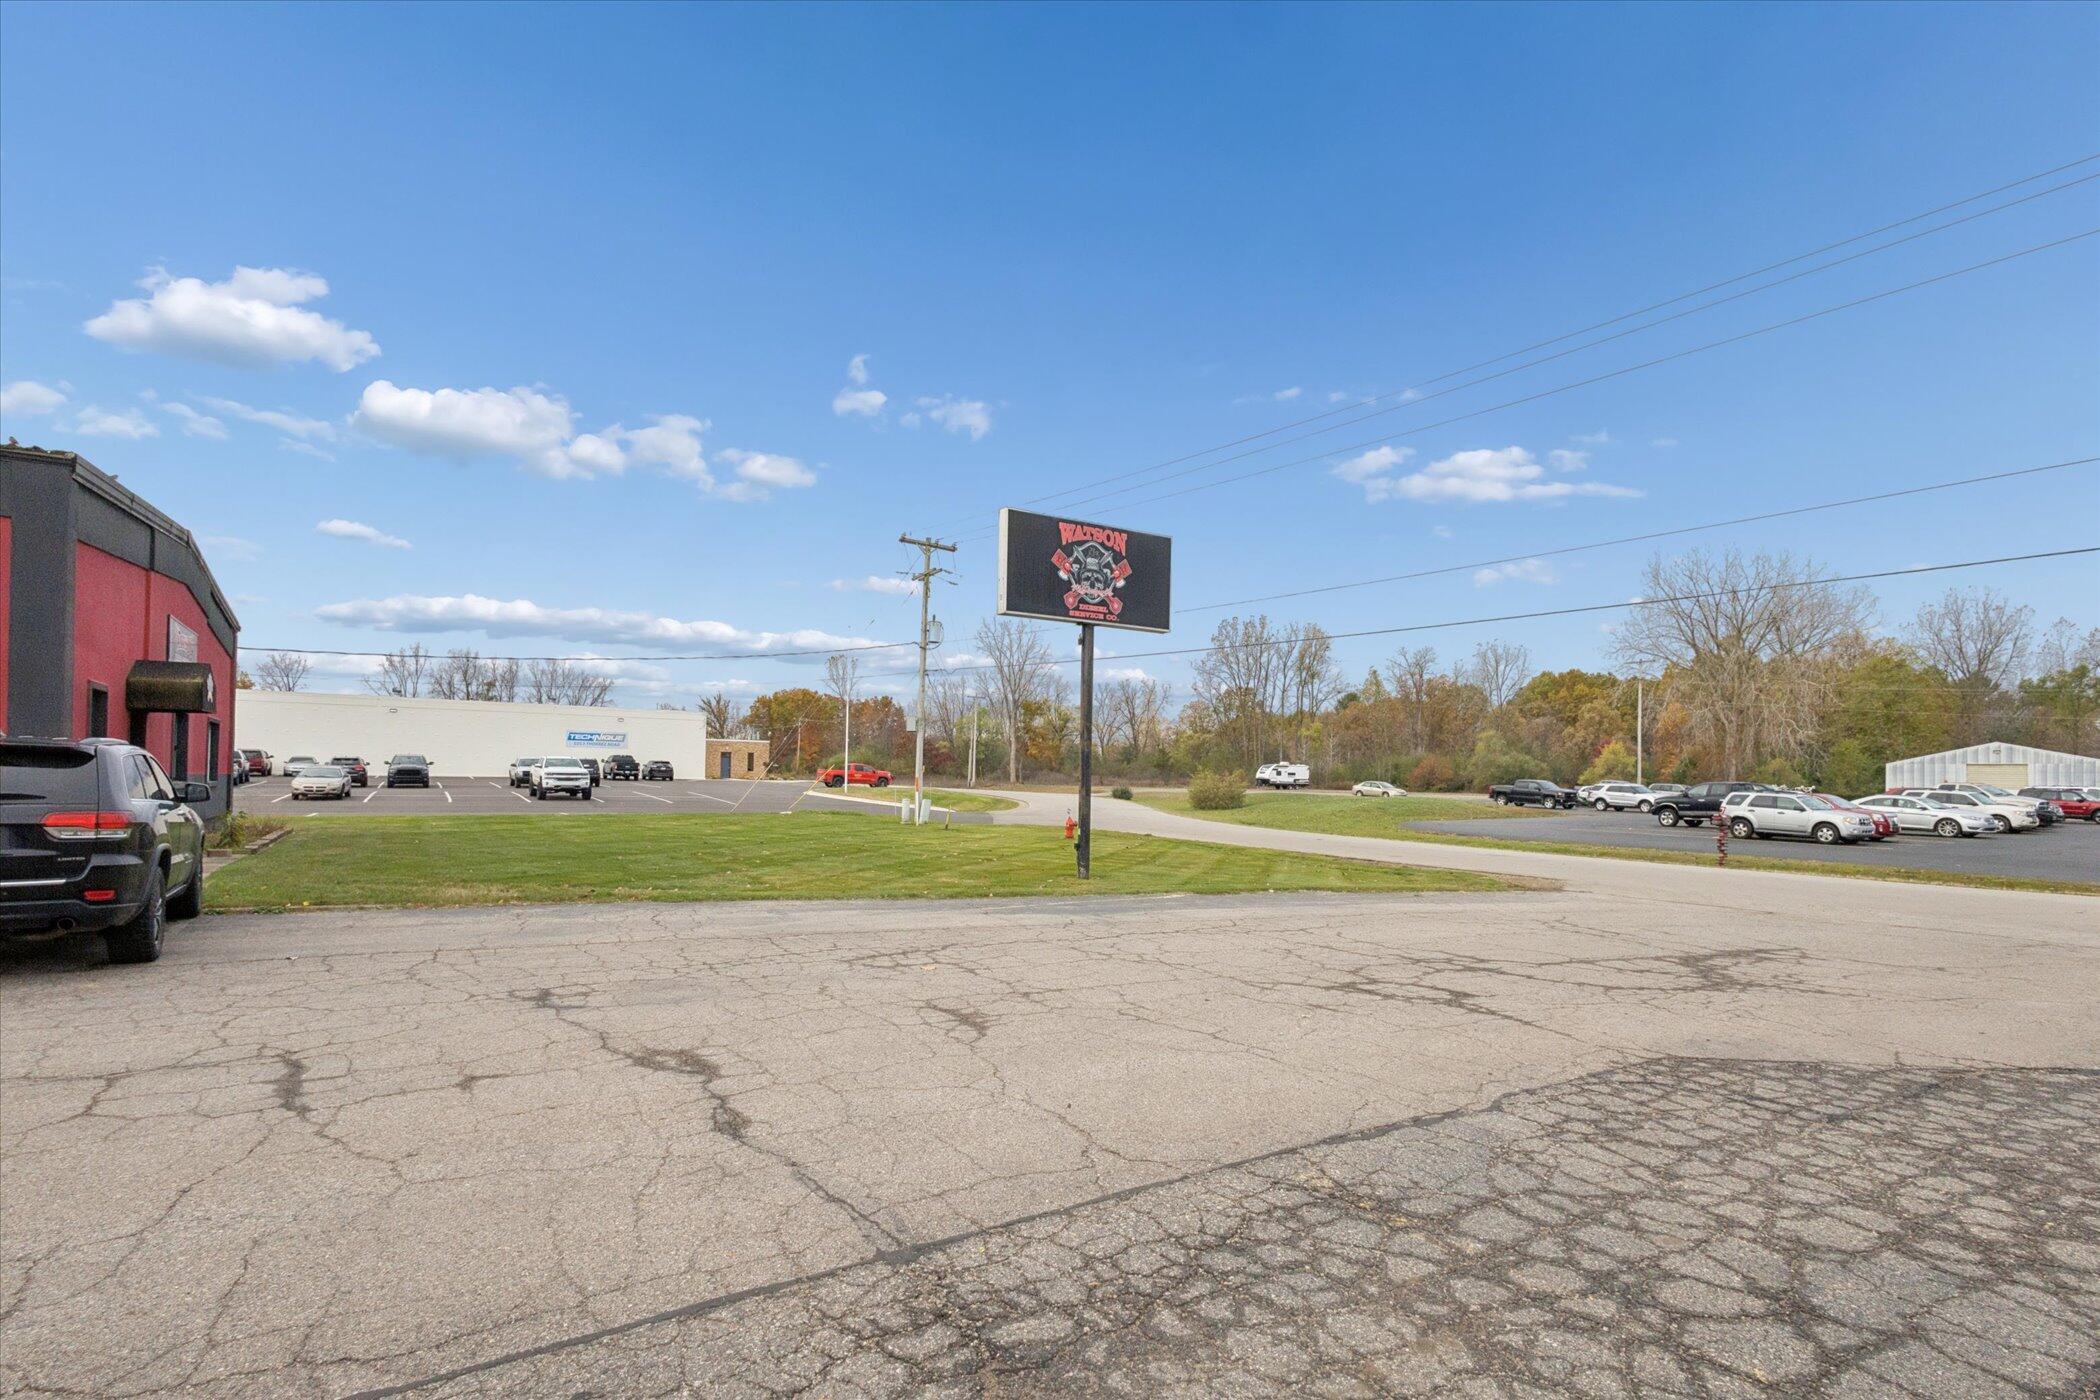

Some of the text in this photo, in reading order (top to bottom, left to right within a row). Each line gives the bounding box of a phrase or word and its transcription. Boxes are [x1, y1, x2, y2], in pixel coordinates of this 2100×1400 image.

[1059, 522, 1127, 556] WATSON
[1078, 604, 1109, 613] DIESEL
[1069, 611, 1104, 619] SERVICE
[569, 732, 625, 741] TECHNIQUE
